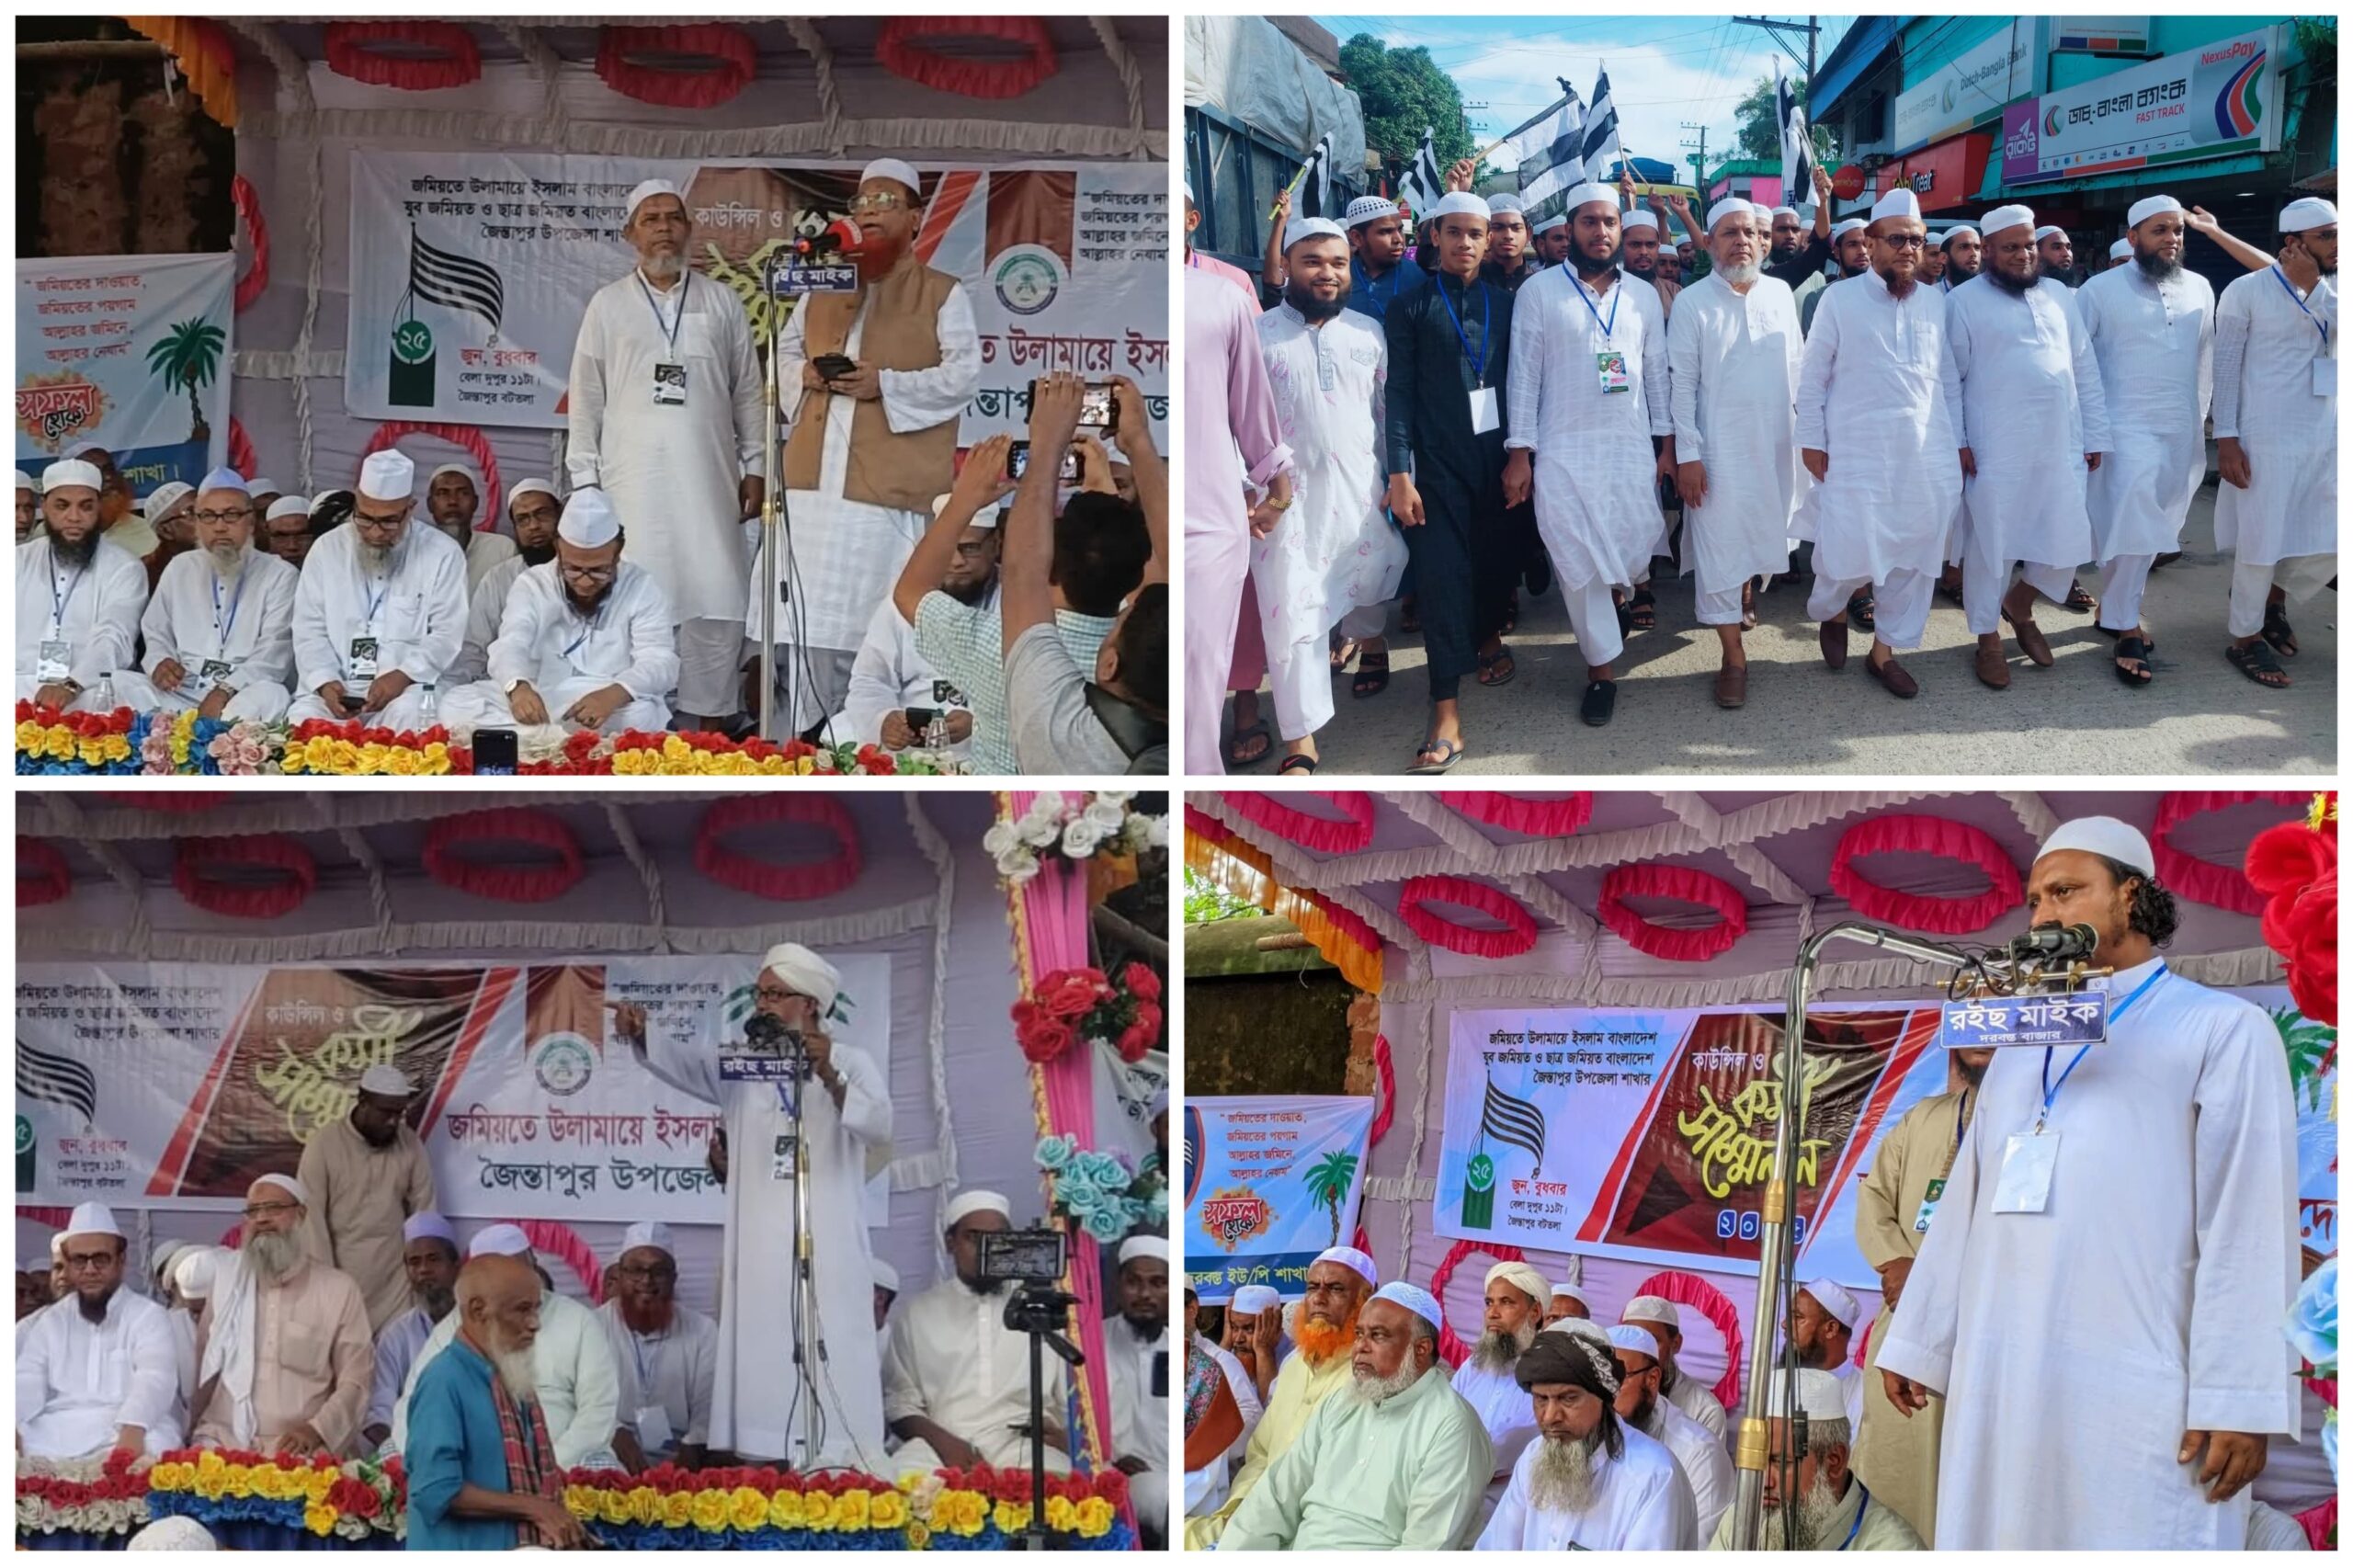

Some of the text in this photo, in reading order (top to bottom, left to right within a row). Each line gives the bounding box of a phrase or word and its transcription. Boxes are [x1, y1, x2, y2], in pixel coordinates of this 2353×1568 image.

[2201, 40, 2256, 65] NexusPay
[1961, 56, 2006, 91] Dutch-Bangla
[2007, 42, 2028, 65] Bank
[2137, 78, 2187, 108] ব্যাংক
[2136, 103, 2185, 124] FAST TRACK
[412, 176, 465, 194] জমিয়তে
[531, 177, 576, 199] ইসলাম
[404, 200, 423, 217] যুব
[427, 198, 475, 216] জমিয়ত
[482, 203, 492, 216] ও
[497, 203, 523, 218] ছাত্র
[769, 210, 782, 228] ও
[808, 267, 854, 283] মাইক
[400, 330, 427, 351] ২৫
[1006, 324, 1117, 371] উলামায়ে
[1948, 996, 2101, 1031] রইছ মাইক
[1489, 1029, 1657, 1046] জমিয়তে উলামায়ে ইসলাম বাংলাদেশ
[2020, 1031, 2062, 1041] বাজার
[1483, 1049, 1654, 1066] যুব জমিয়ত ও ছাত্র জমিয়ত বাংলাদেশ
[1692, 1046, 1765, 1072] কাউন্সিল ও
[1533, 1069, 1652, 1087] জৈন্তাপুর উপজেলা শাখার
[448, 1103, 540, 1144] জমিয়তে
[547, 1105, 645, 1146] উলামায়ে
[479, 1154, 599, 1199] জৈন্তাপুর
[1472, 1162, 1490, 1181] ২৫
[1512, 1179, 1567, 1197] জুন, বুধবার
[1510, 1199, 1525, 1210] বেলা
[1527, 1201, 1543, 1213] দুপুর
